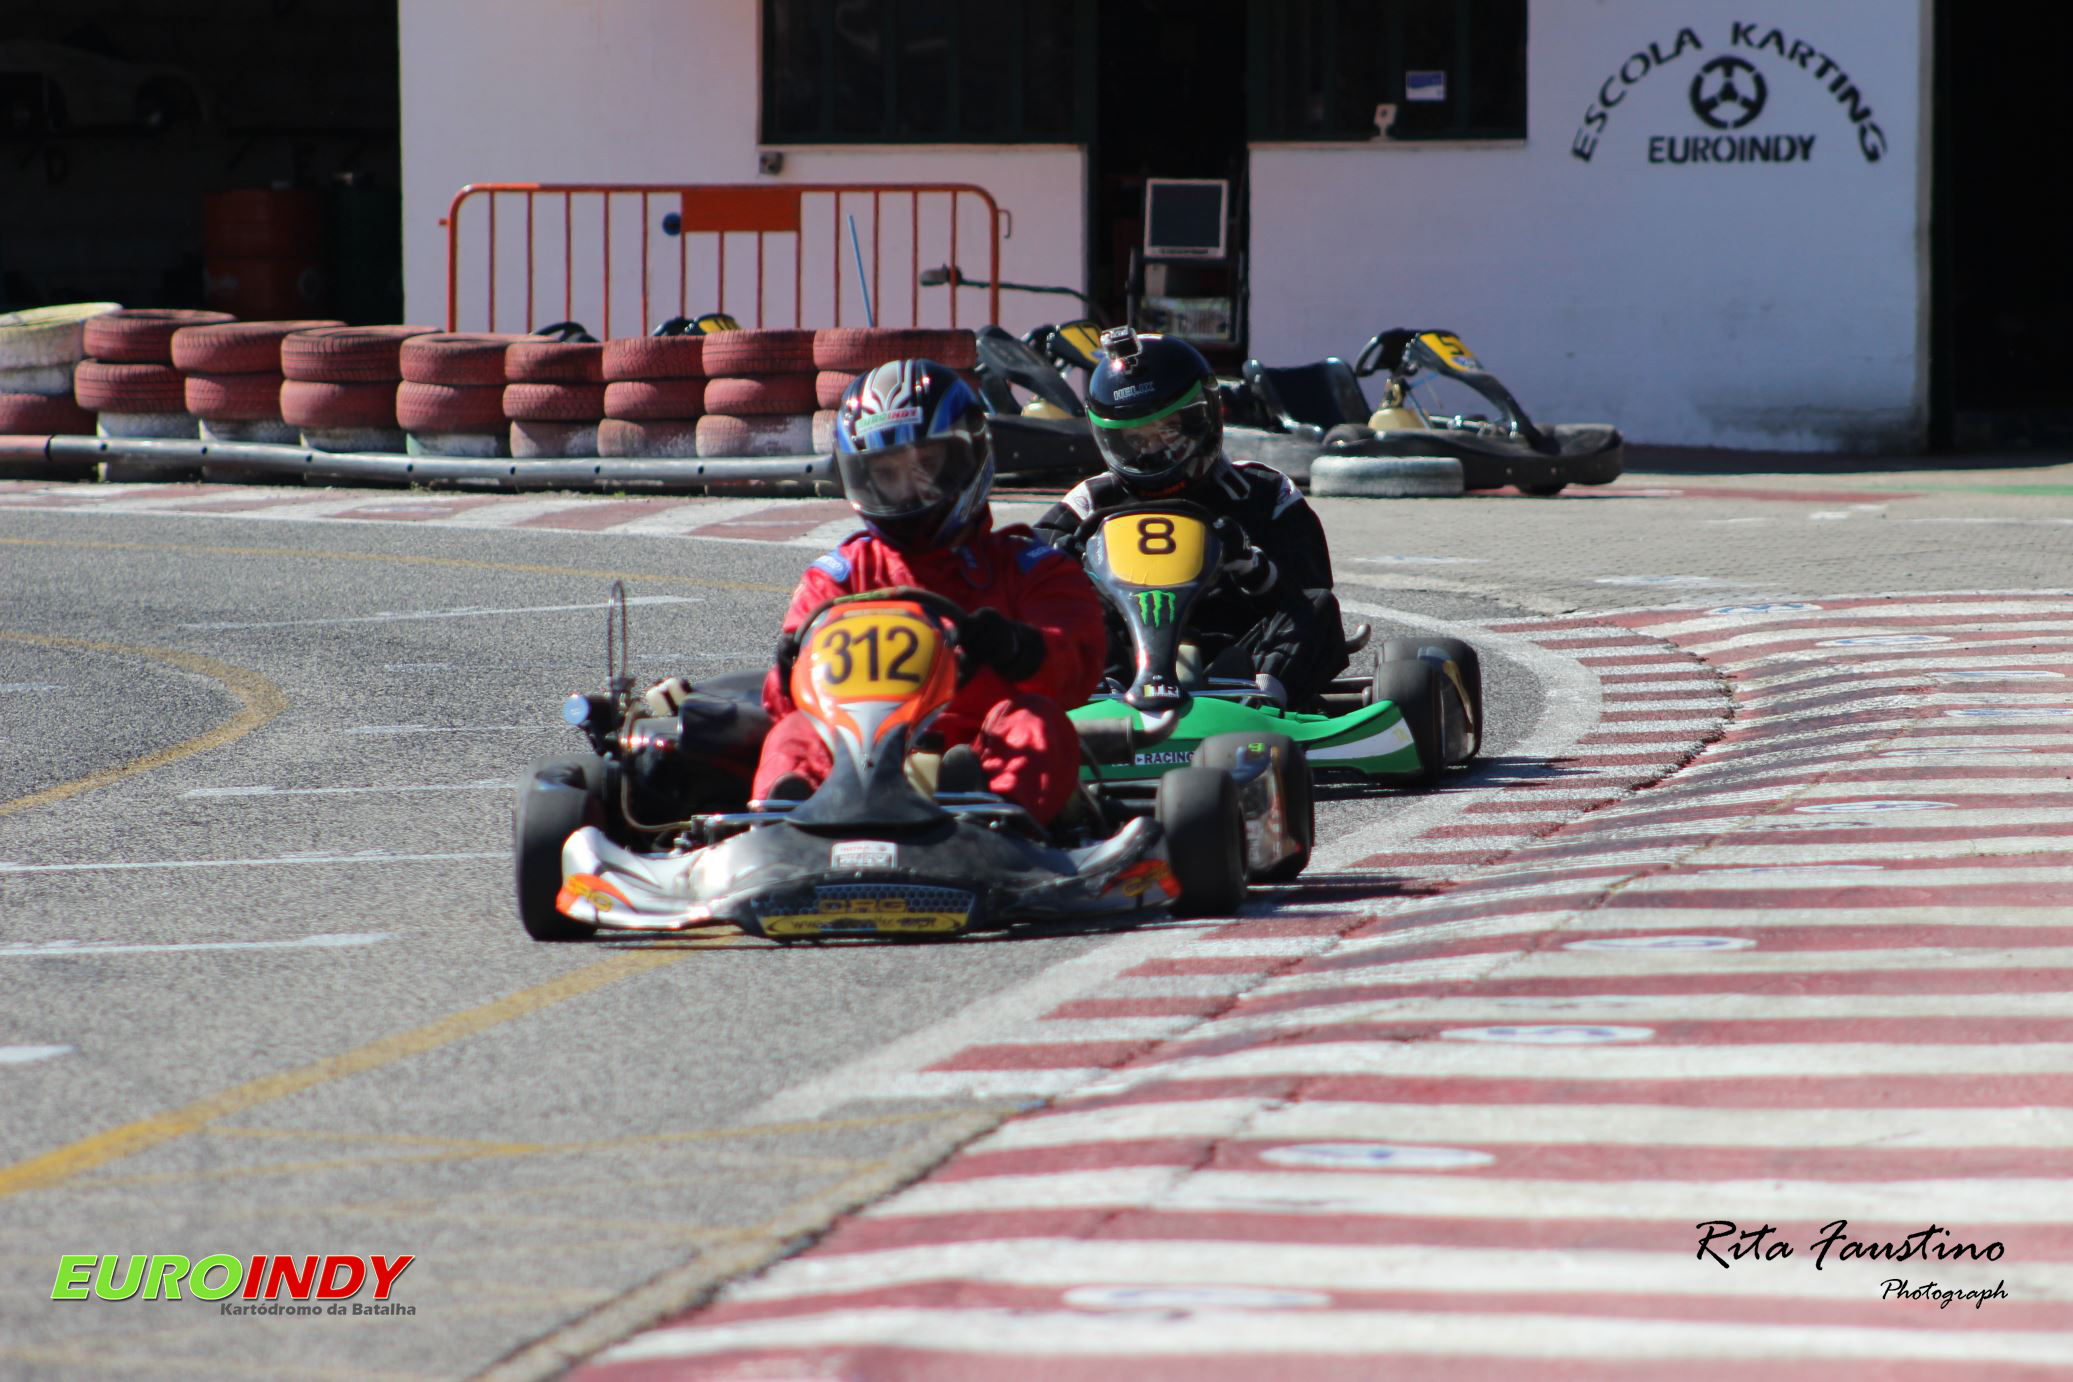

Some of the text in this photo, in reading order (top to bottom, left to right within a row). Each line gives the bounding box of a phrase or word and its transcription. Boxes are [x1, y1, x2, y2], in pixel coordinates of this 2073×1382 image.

[1571, 21, 1888, 163] ESCOLA KARTING
[1648, 135, 1816, 164] EUROINDY
[1137, 517, 1177, 555] 8
[823, 625, 920, 685] 312
